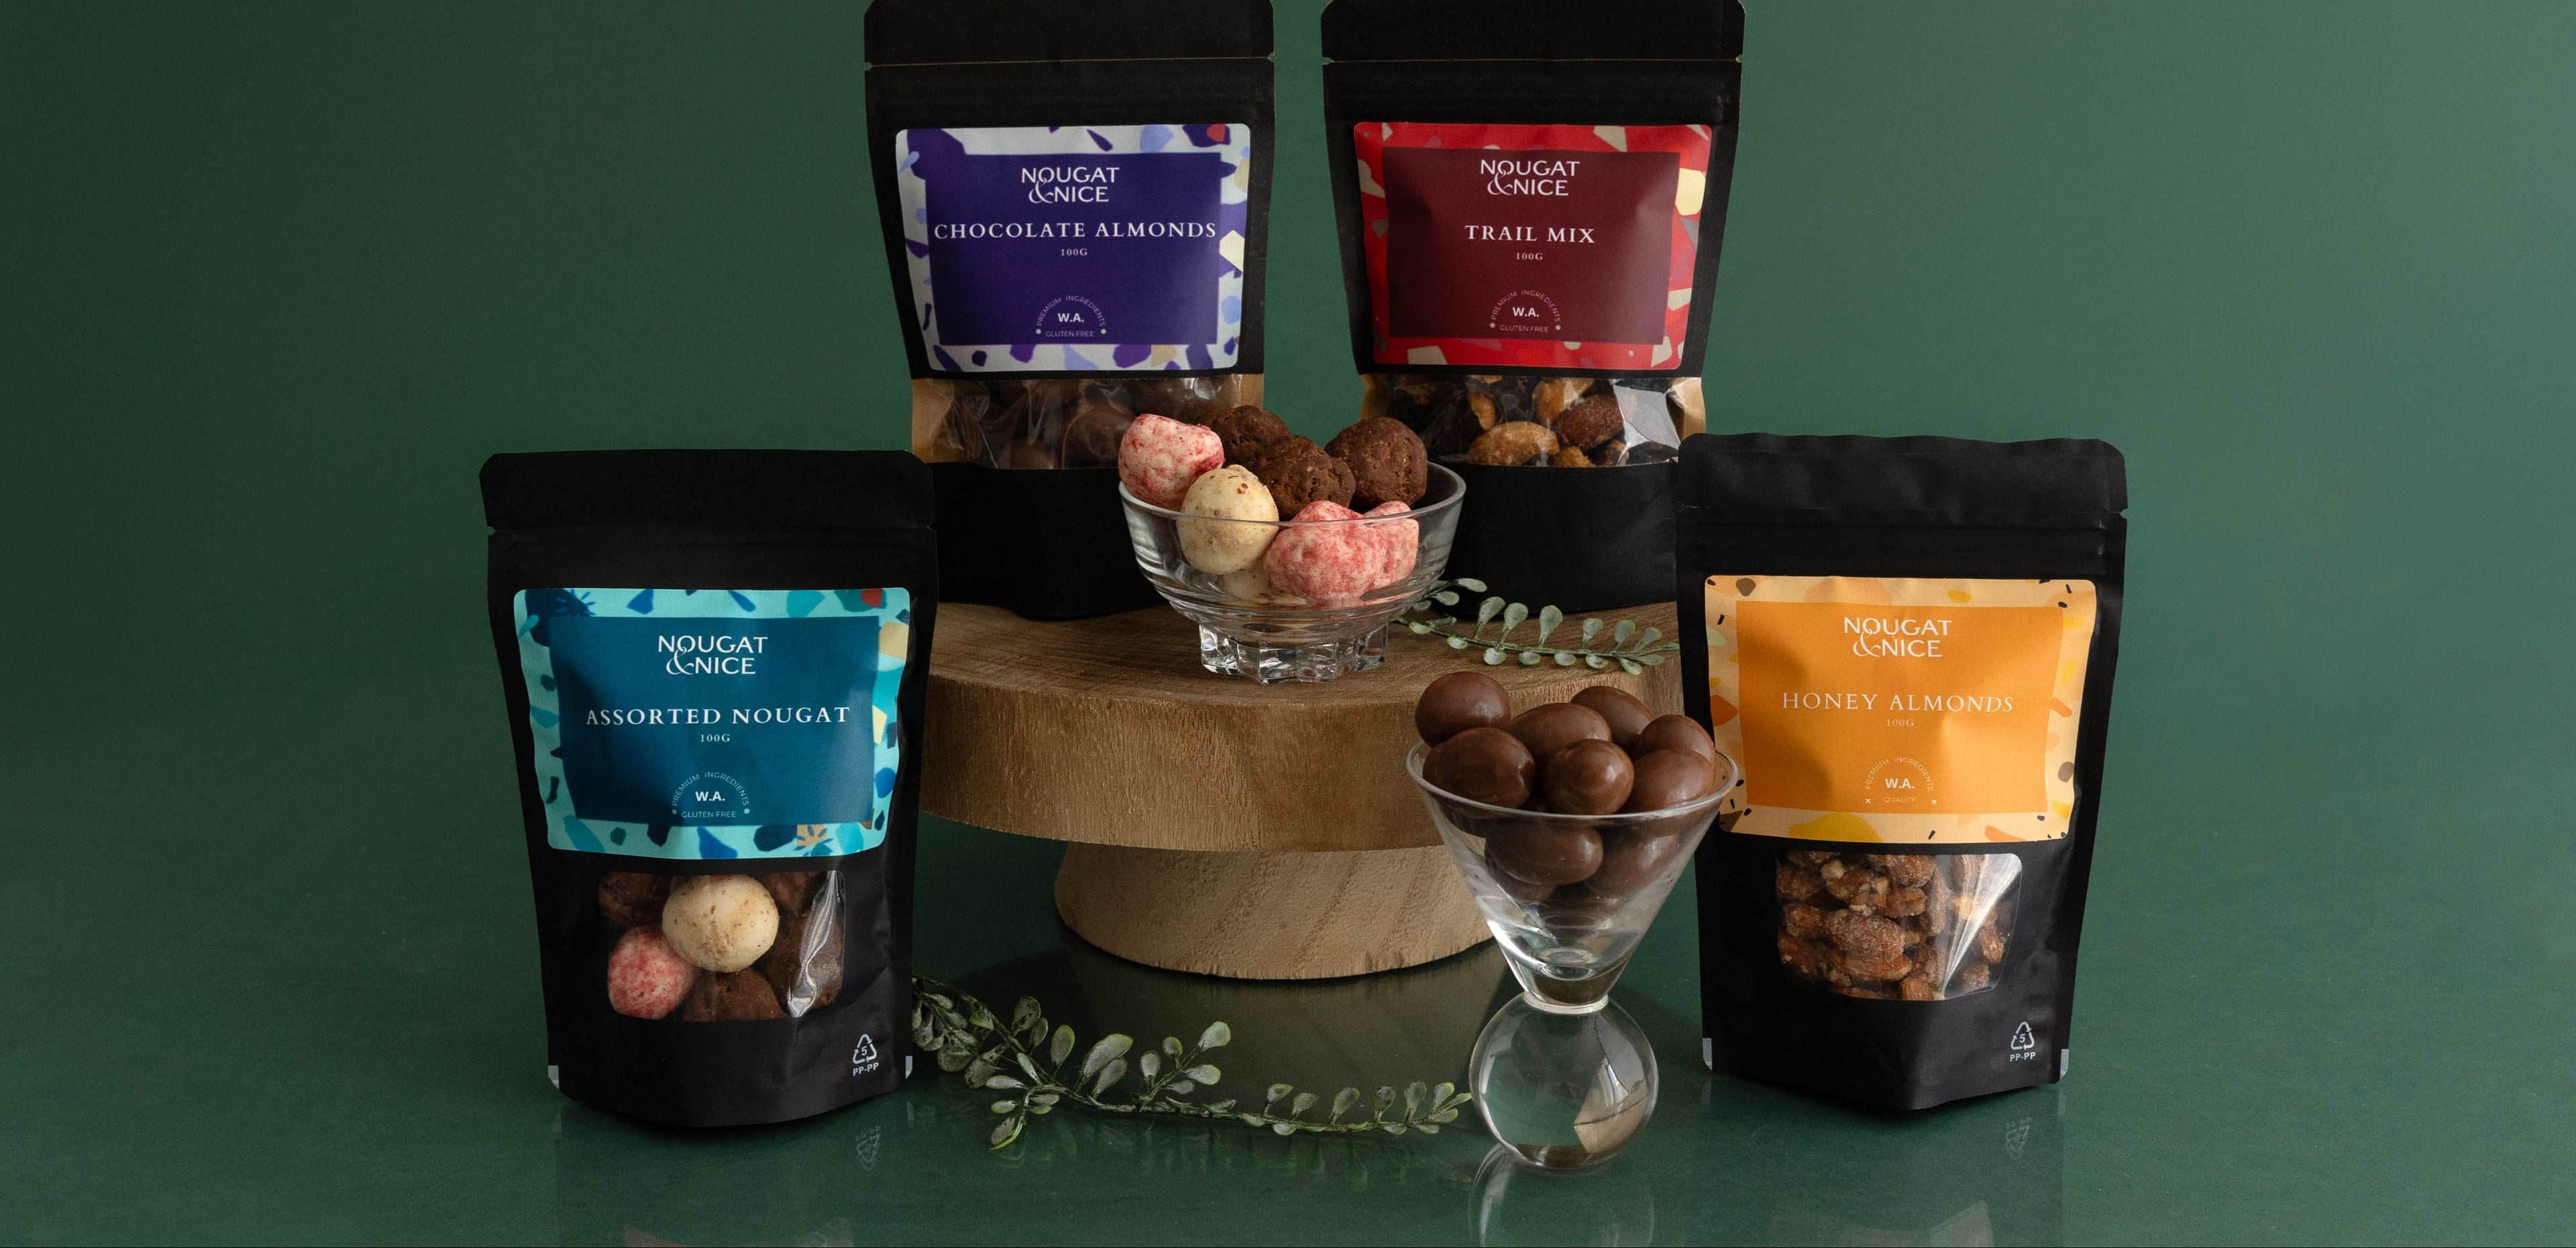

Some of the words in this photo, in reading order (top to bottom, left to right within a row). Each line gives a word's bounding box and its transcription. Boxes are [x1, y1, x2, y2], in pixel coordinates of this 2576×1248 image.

[1021, 166, 1120, 184] NOUGAT
[1481, 160, 1580, 176] NOUGAT
[1028, 178, 1110, 203] &NICE
[1487, 170, 1569, 196] &NICE
[934, 222, 1086, 239] CHOCOLATE
[1095, 222, 1216, 238] ALMONDS
[1464, 225, 1538, 242] TRAIL
[1547, 227, 1595, 244] MIX
[1061, 248, 1088, 256] 100G
[1515, 252, 1544, 260] 100G
[1036, 297, 1063, 327] PREMIUM
[1065, 295, 1106, 327] INGREDIENTS
[1491, 291, 1517, 320] PREMIUM
[1521, 289, 1561, 322] INGREDIENTS
[1512, 307, 1540, 317] W.A.
[1057, 313, 1084, 322] W.A.
[1844, 617, 1952, 636] NOUGAT
[658, 635, 768, 654] NOUGAT
[1853, 629, 1943, 658] &NICE
[666, 647, 756, 675] &NICE
[1782, 692, 1878, 711] HONEY
[1888, 694, 2013, 713] ALMONDS
[586, 709, 721, 725] ASSORTED
[732, 707, 851, 724] NOUGAT
[1886, 718, 1915, 727] 100G
[700, 734, 731, 743] 100G
[1864, 759, 1890, 790] PREMIUM
[1894, 756, 1934, 792] INGREDIENTS
[672, 774, 700, 807] PREMIUM
[704, 772, 749, 806] INGREDIENTS
[1884, 778, 1915, 788] W.A.
[695, 791, 725, 801] W.A.
[2019, 1033, 2026, 1043] 5
[861, 1045, 867, 1056] 5
[2010, 1051, 2036, 1061] PP-PP
[853, 1062, 879, 1076] PP-PP
